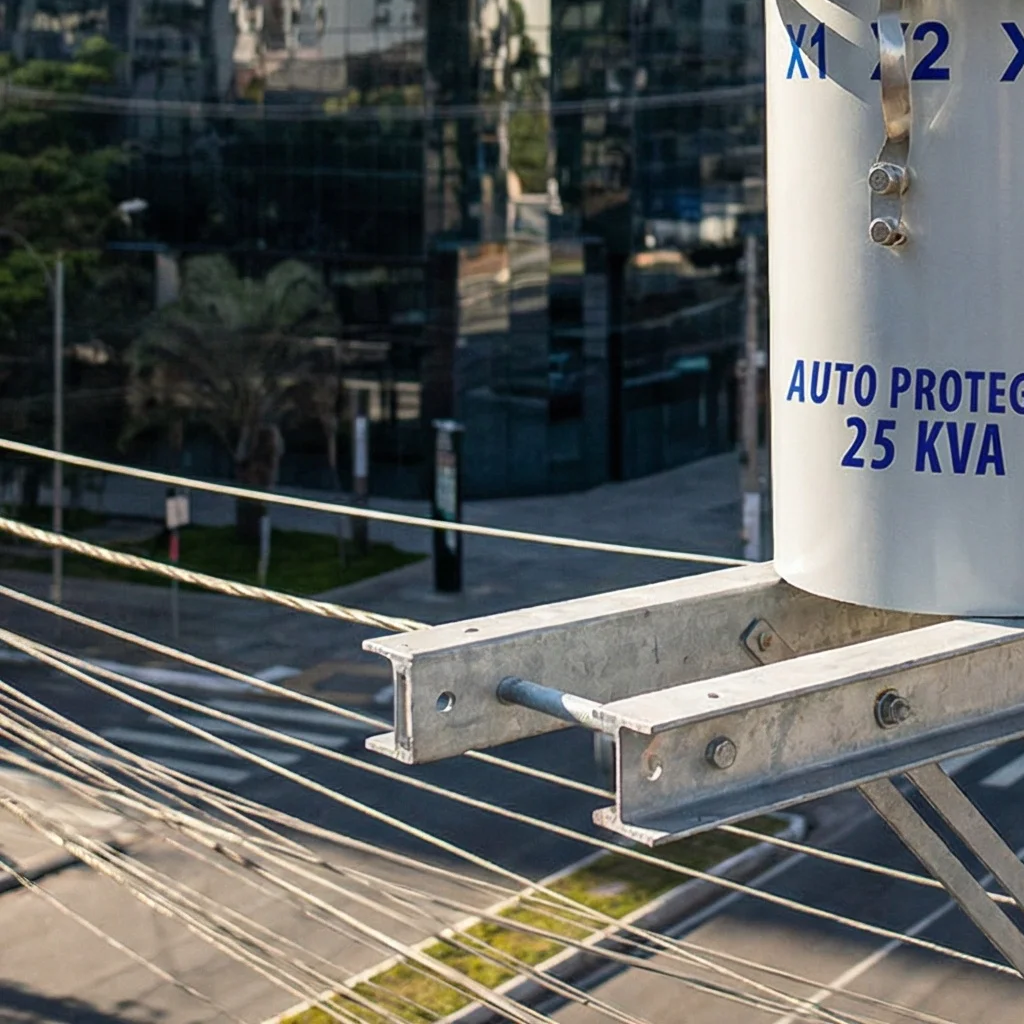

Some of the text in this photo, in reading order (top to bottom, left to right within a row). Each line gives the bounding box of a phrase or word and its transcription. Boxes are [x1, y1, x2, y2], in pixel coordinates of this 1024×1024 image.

[785, 22, 827, 80] X1
[786, 359, 877, 407] AUTO
[841, 416, 1005, 476] 25 KVA
